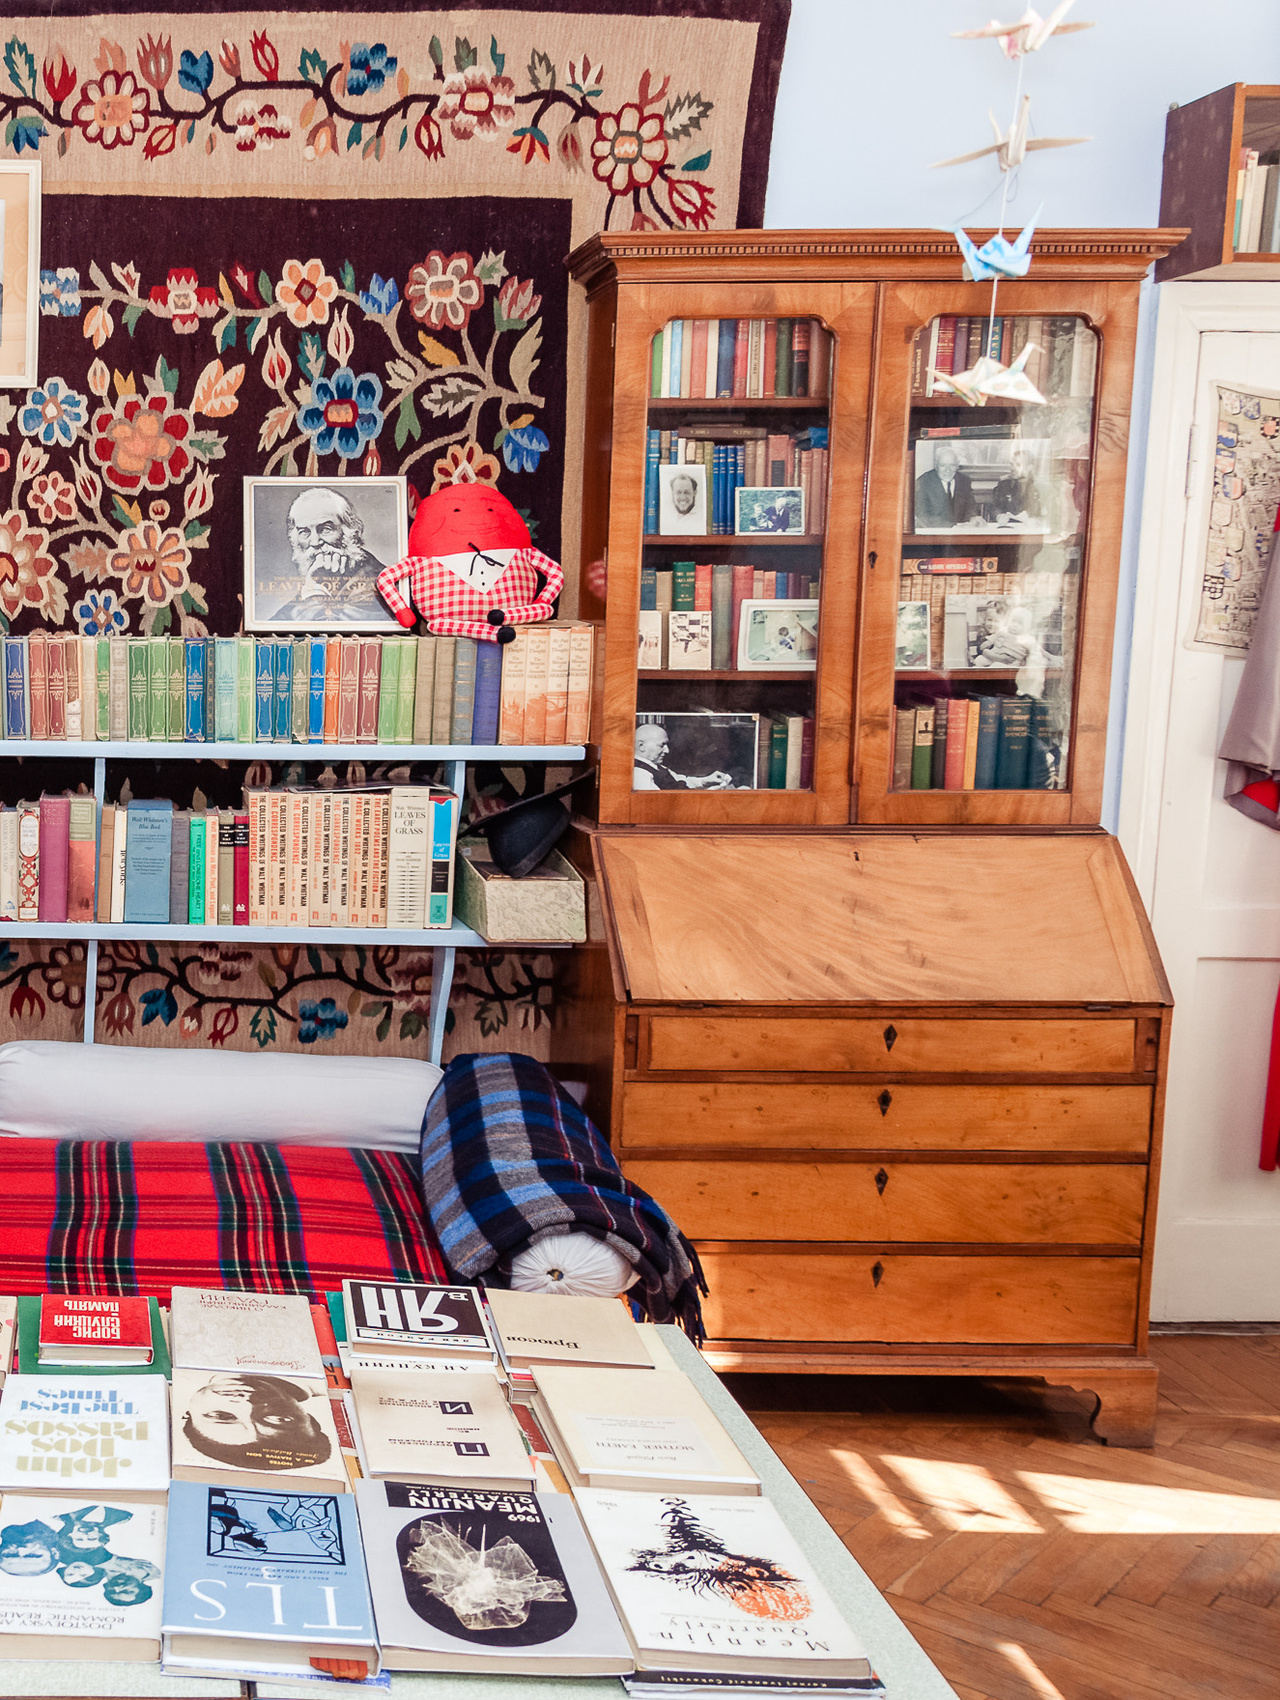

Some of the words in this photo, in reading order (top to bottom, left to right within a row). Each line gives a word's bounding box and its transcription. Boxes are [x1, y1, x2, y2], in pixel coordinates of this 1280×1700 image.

[333, 801, 341, 811] THE
[355, 797, 363, 816] PROSE
[363, 798, 371, 806] THE
[373, 798, 381, 809] THE
[381, 798, 389, 806] THE
[342, 807, 350, 834] COLLECTED
[363, 807, 371, 835] COLLECTED
[373, 810, 381, 826] EARLY
[381, 807, 389, 835] COLLECTED
[394, 811, 426, 819] LEAVES
[355, 819, 363, 839] WORKS
[403, 819, 415, 827] OF
[7, 819, 15, 843] AGAINST
[373, 828, 381, 847] POEMS
[395, 827, 424, 835] GRASS
[333, 813, 341, 865] CORRESPONDENCE
[341, 836, 349, 859] WRITINGS
[354, 842, 362, 855] 1892
[361, 837, 370, 860] WRITINGS
[380, 837, 388, 860] WRITINGS
[360, 869, 368, 883] WALT
[372, 871, 380, 893] FICTION
[360, 885, 368, 908] WHITMAN
[64, 1300, 119, 1312] ПАМЯТЬ
[360, 1286, 459, 1333] ЯН
[54, 1315, 120, 1328] СЛУЦКИЙ
[73, 1326, 120, 1339] БОРИС
[506, 1336, 581, 1350] Брюсов
[37, 1389, 124, 1403] Times
[20, 1400, 80, 1415] Best
[84, 1402, 139, 1415] The
[4, 1420, 149, 1441] Passos
[30, 1437, 114, 1457] Dos
[262, 1448, 293, 1456] Baldwin
[596, 1442, 637, 1450] EARTH
[265, 1453, 292, 1461] NATIVE
[269, 1459, 293, 1467] NOTES
[16, 1456, 132, 1478] John
[408, 1490, 533, 1504] QUARTERLY
[408, 1496, 538, 1515] MEANJIN
[507, 1514, 540, 1523] 1969
[260, 1566, 276, 1580] 3
[190, 1579, 363, 1631] TLS
[15, 1618, 112, 1631] DOSTOEVSKY
[46, 1612, 125, 1623] ROMANTIC
[668, 1617, 809, 1637] Quarterly
[659, 1631, 831, 1652] Meanjin
